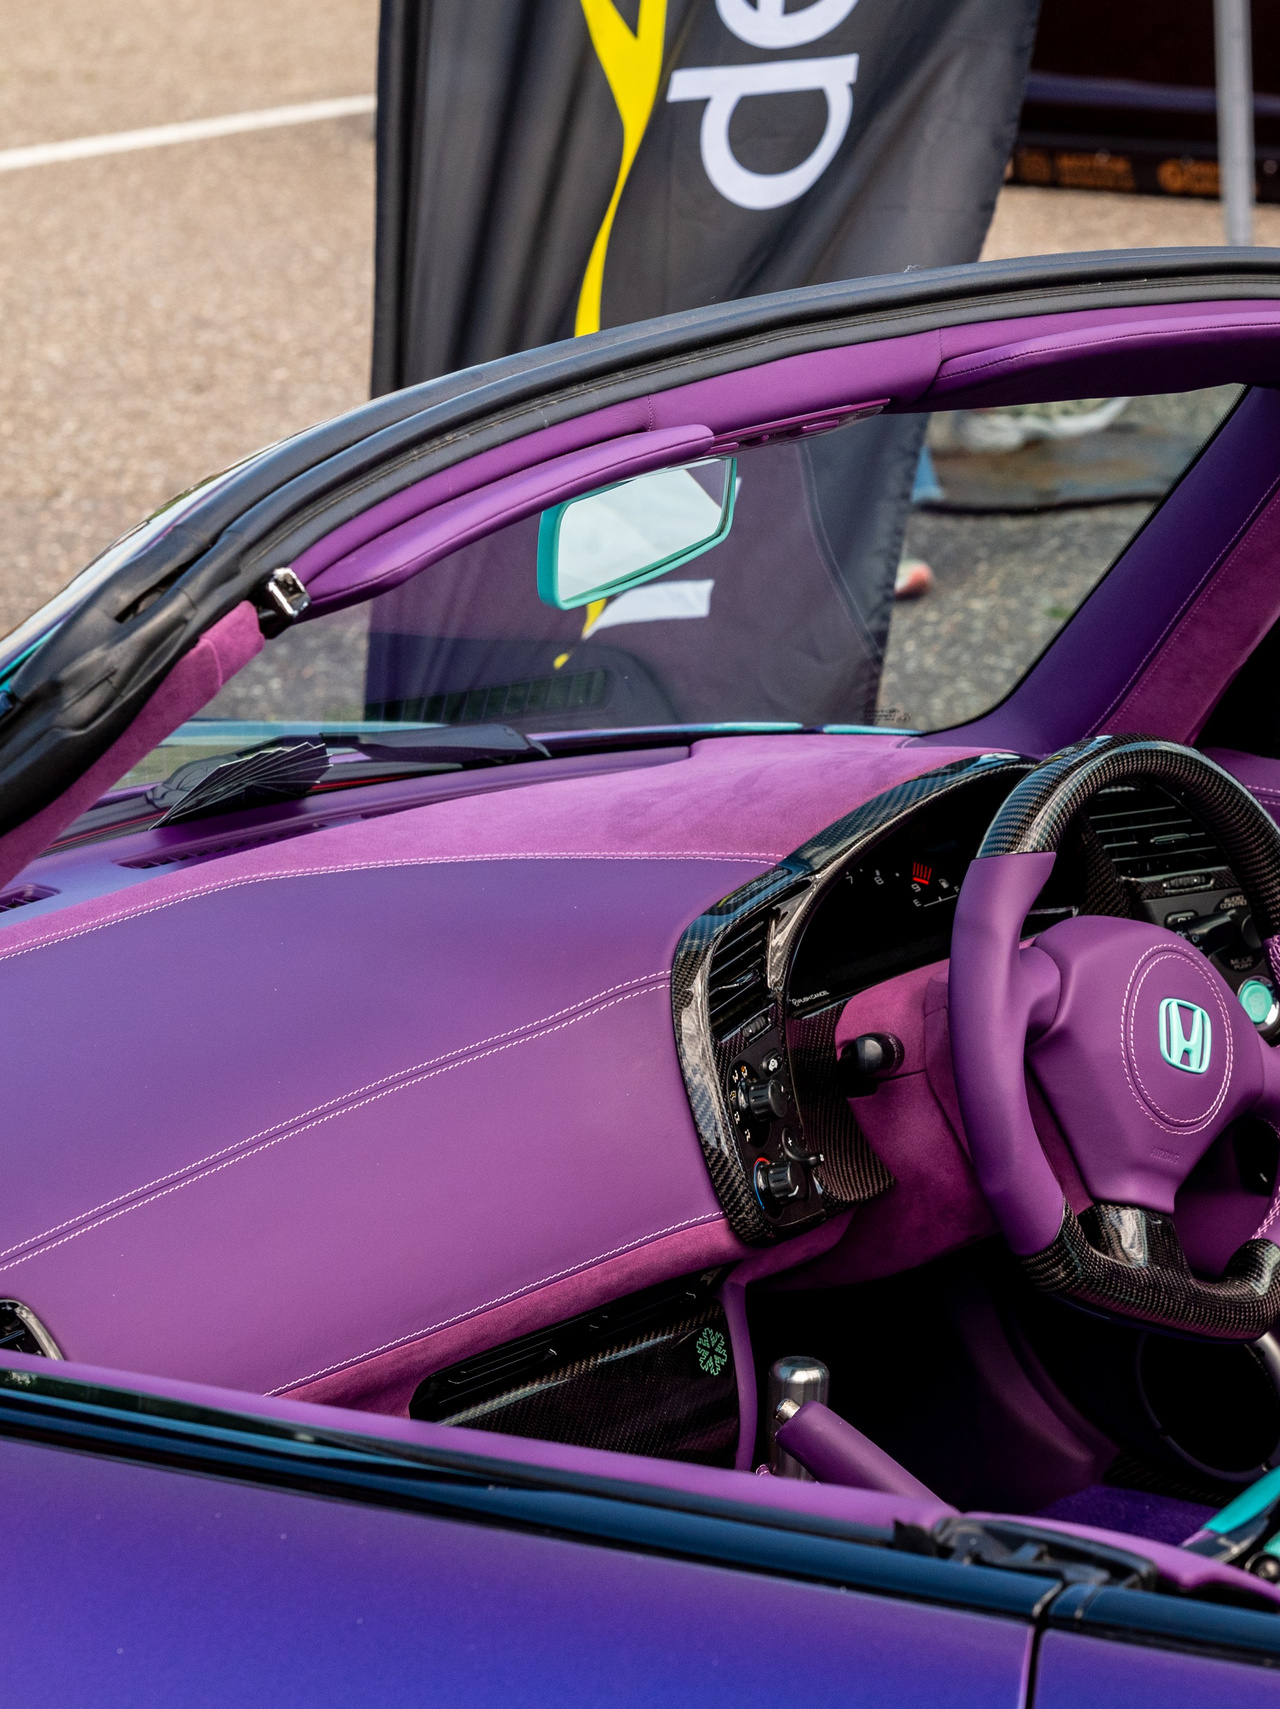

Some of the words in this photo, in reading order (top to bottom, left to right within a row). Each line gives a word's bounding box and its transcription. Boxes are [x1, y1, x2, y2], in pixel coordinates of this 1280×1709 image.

[845, 875, 853, 885] 7
[874, 876, 884, 885] 8
[911, 883, 922, 893] 9
[913, 899, 922, 907] E
[1220, 899, 1248, 909] CONTRO
